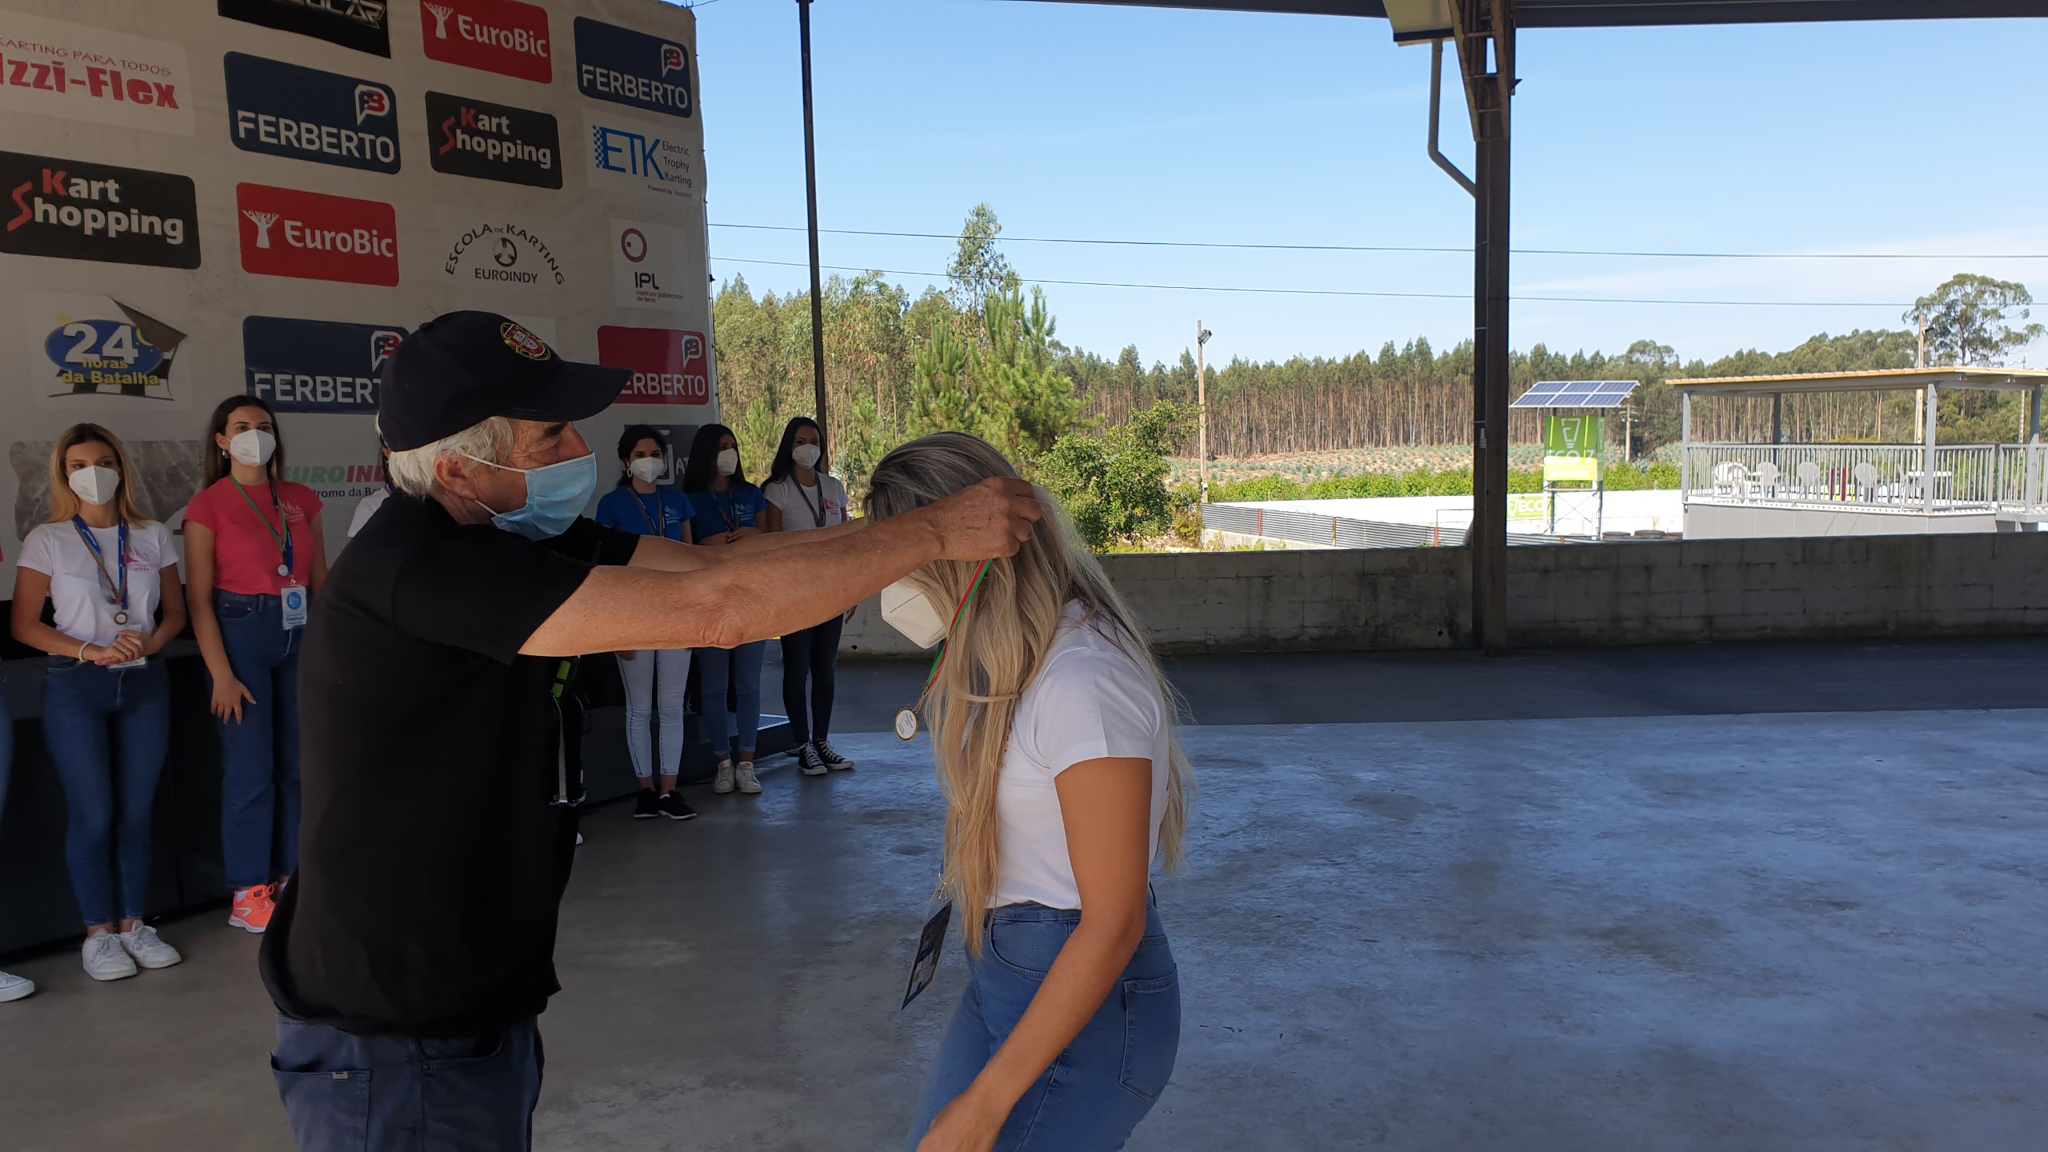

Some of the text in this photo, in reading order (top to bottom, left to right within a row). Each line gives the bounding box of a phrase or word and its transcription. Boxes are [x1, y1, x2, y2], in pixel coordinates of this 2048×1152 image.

[457, 14, 549, 58] EuroBic
[0, 53, 180, 110] zzi-Flex
[72, 50, 117, 68] PARA
[119, 59, 172, 77] TODOS
[581, 63, 689, 110] FERBERTO
[237, 110, 395, 164] FERBERTO
[460, 107, 510, 136] Kart
[440, 116, 552, 170] Shopping
[602, 126, 664, 181] ETK
[662, 140, 690, 157] Electric
[663, 155, 690, 173] Trophy
[664, 171, 692, 189] Karting
[42, 168, 121, 204] Kart
[7, 181, 184, 246] Shopping
[284, 219, 394, 258] EuroBic
[445, 223, 494, 276] ESCOLA
[506, 223, 566, 286] KARTING
[474, 267, 539, 285] EUROINDY
[634, 271, 660, 291] IPL
[63, 323, 139, 364] 24
[61, 370, 160, 385] da Batalha
[254, 372, 382, 405] FERBERT
